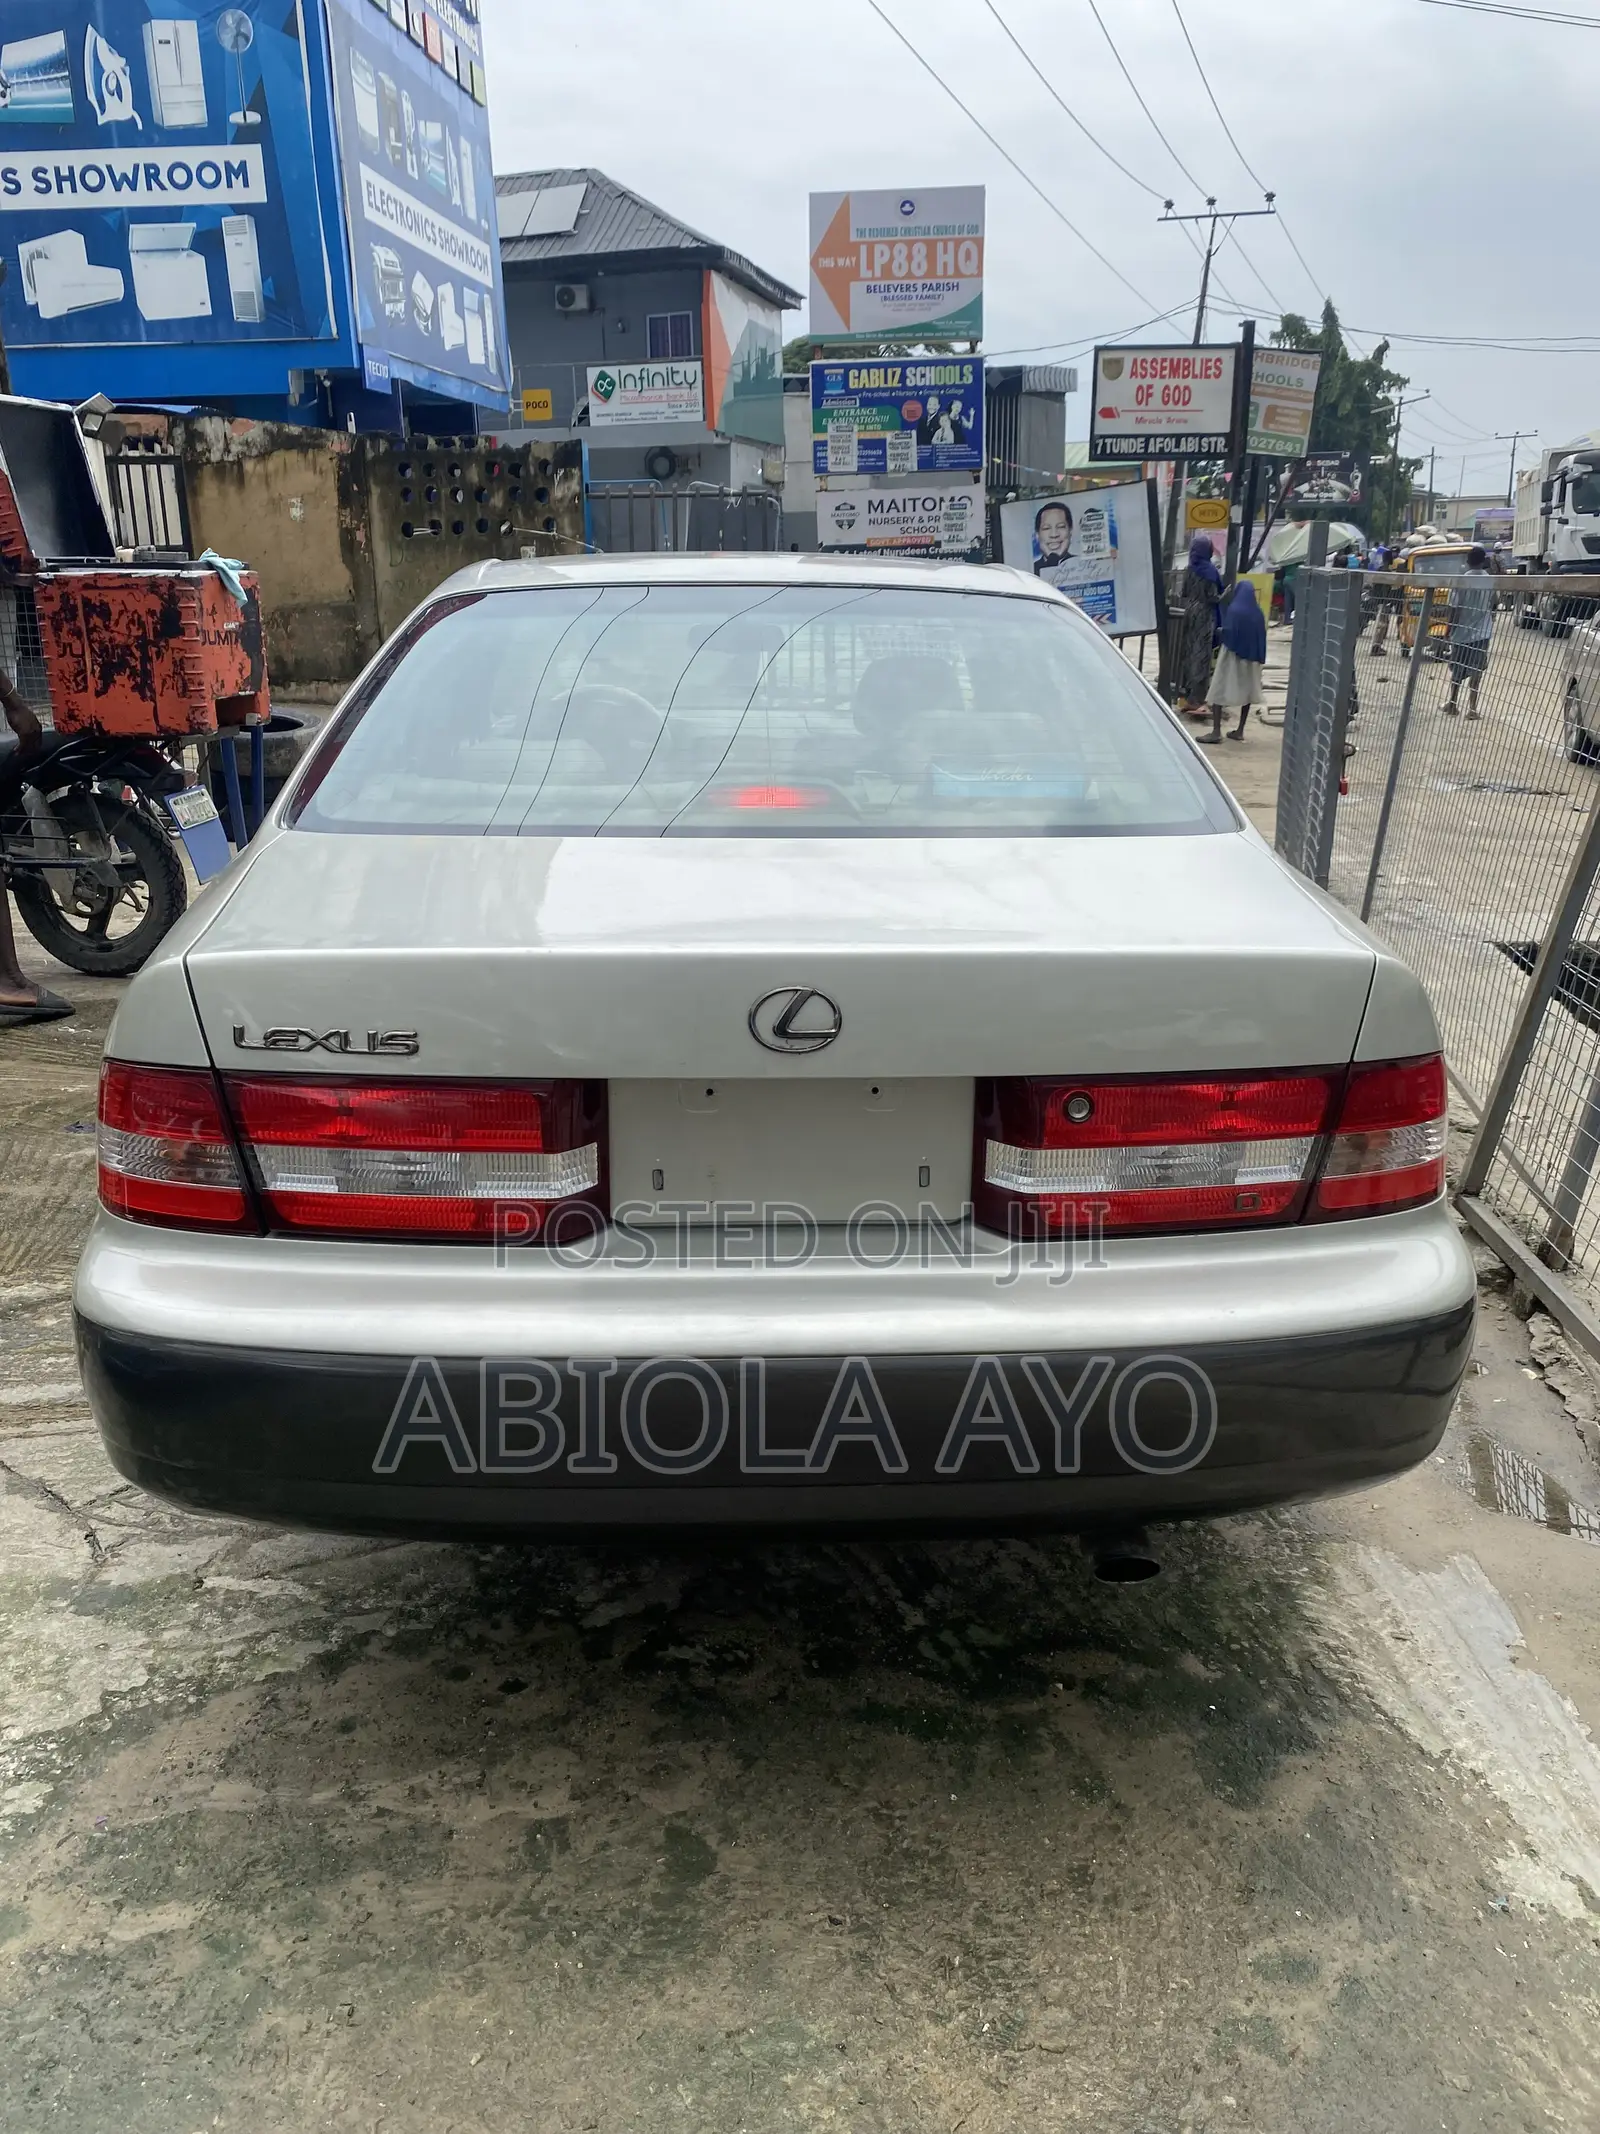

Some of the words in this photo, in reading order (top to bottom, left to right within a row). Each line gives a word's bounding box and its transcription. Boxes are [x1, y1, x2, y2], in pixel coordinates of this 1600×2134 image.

[32, 160, 249, 194] SHOWROOM
[366, 180, 437, 245] ELECTRONICS
[439, 225, 489, 276] SHOWROOM
[856, 228, 866, 238] THE
[900, 226, 931, 237] CHRISTIAN
[933, 225, 956, 236] CHURCH
[958, 225, 966, 235] OF
[968, 224, 979, 234] GOD
[818, 258, 835, 268] THIS
[837, 256, 856, 267] WAY
[860, 242, 927, 277] LP88
[937, 241, 978, 275] HQ
[866, 284, 917, 294] BELIEVERS
[922, 282, 960, 291] PARISH
[881, 294, 913, 302] (BLESSED
[915, 293, 944, 301] FAMILY)
[368, 360, 389, 379] TECNO
[1129, 357, 1223, 379] ASSEMBLIES
[1254, 352, 1320, 371] HBRIDGE
[618, 367, 697, 393] Infinity
[849, 367, 901, 389] GABLIZ
[906, 365, 973, 386] SCHOOLS
[1252, 371, 1304, 388] HOOLS
[1135, 384, 1153, 406] OF
[1161, 385, 1192, 406] GOD
[526, 401, 548, 409] POCO
[833, 408, 877, 416] ENTRANCE
[1095, 439, 1103, 454] 7
[1105, 438, 1145, 454] TUNDE
[1148, 437, 1198, 453] AFOLABI
[1201, 437, 1228, 452] STR.
[1247, 436, 1301, 454] 027641
[868, 515, 914, 526] NURSERY
[1199, 509, 1218, 517] MTN
[900, 526, 941, 535] SCHOOL
[883, 548, 926, 556] Nurudeen
[233, 1024, 420, 1056] LEXUS
